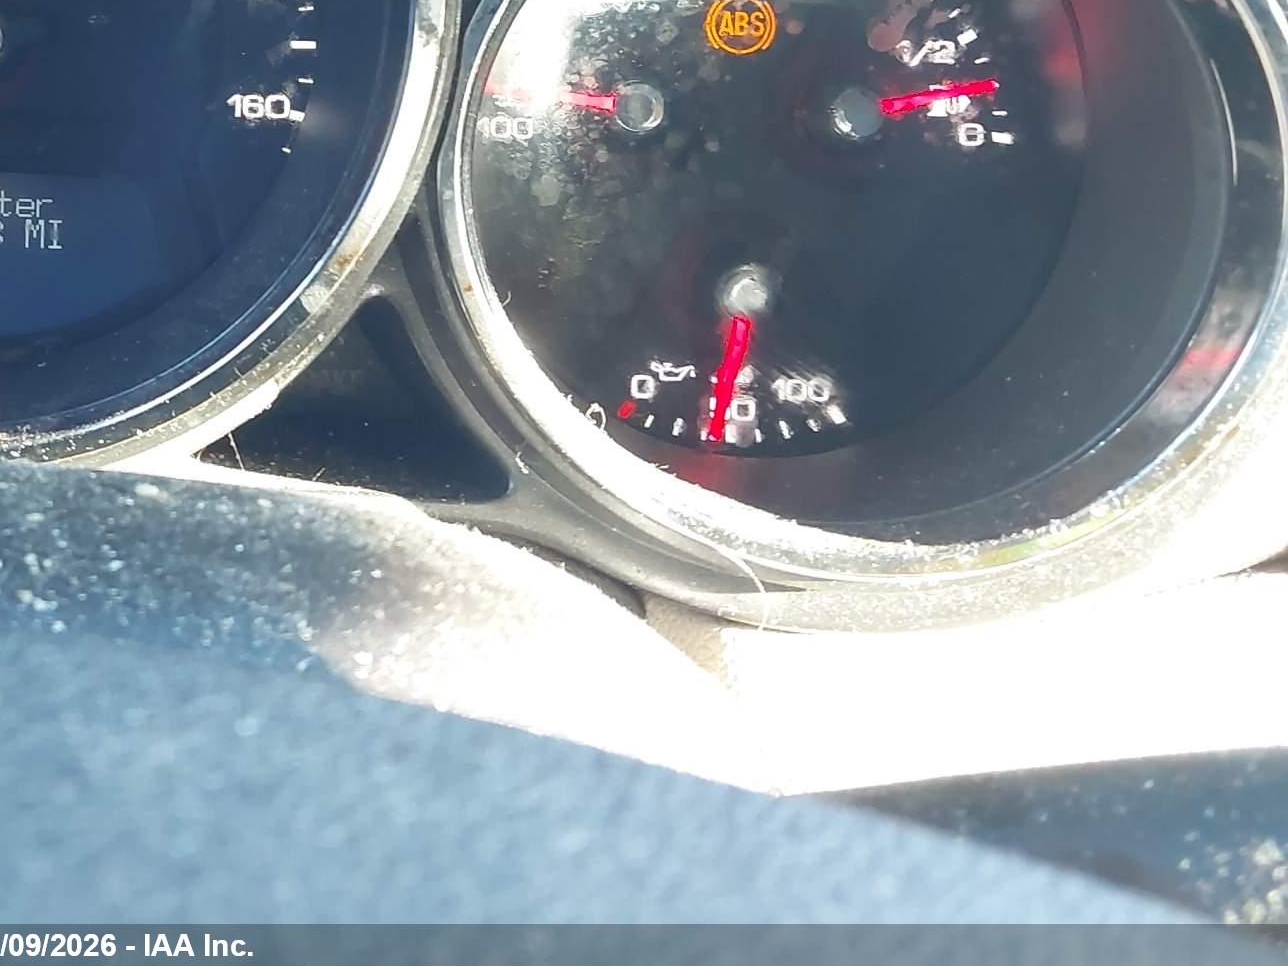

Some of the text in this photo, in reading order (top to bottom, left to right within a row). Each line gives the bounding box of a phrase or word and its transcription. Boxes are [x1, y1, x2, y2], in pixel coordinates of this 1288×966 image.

[719, 11, 765, 36] ABS
[226, 93, 291, 119] 160
[958, 122, 985, 147] 0
[24, 219, 63, 249] MI
[631, 375, 655, 400] 0
[773, 379, 830, 403] 100
